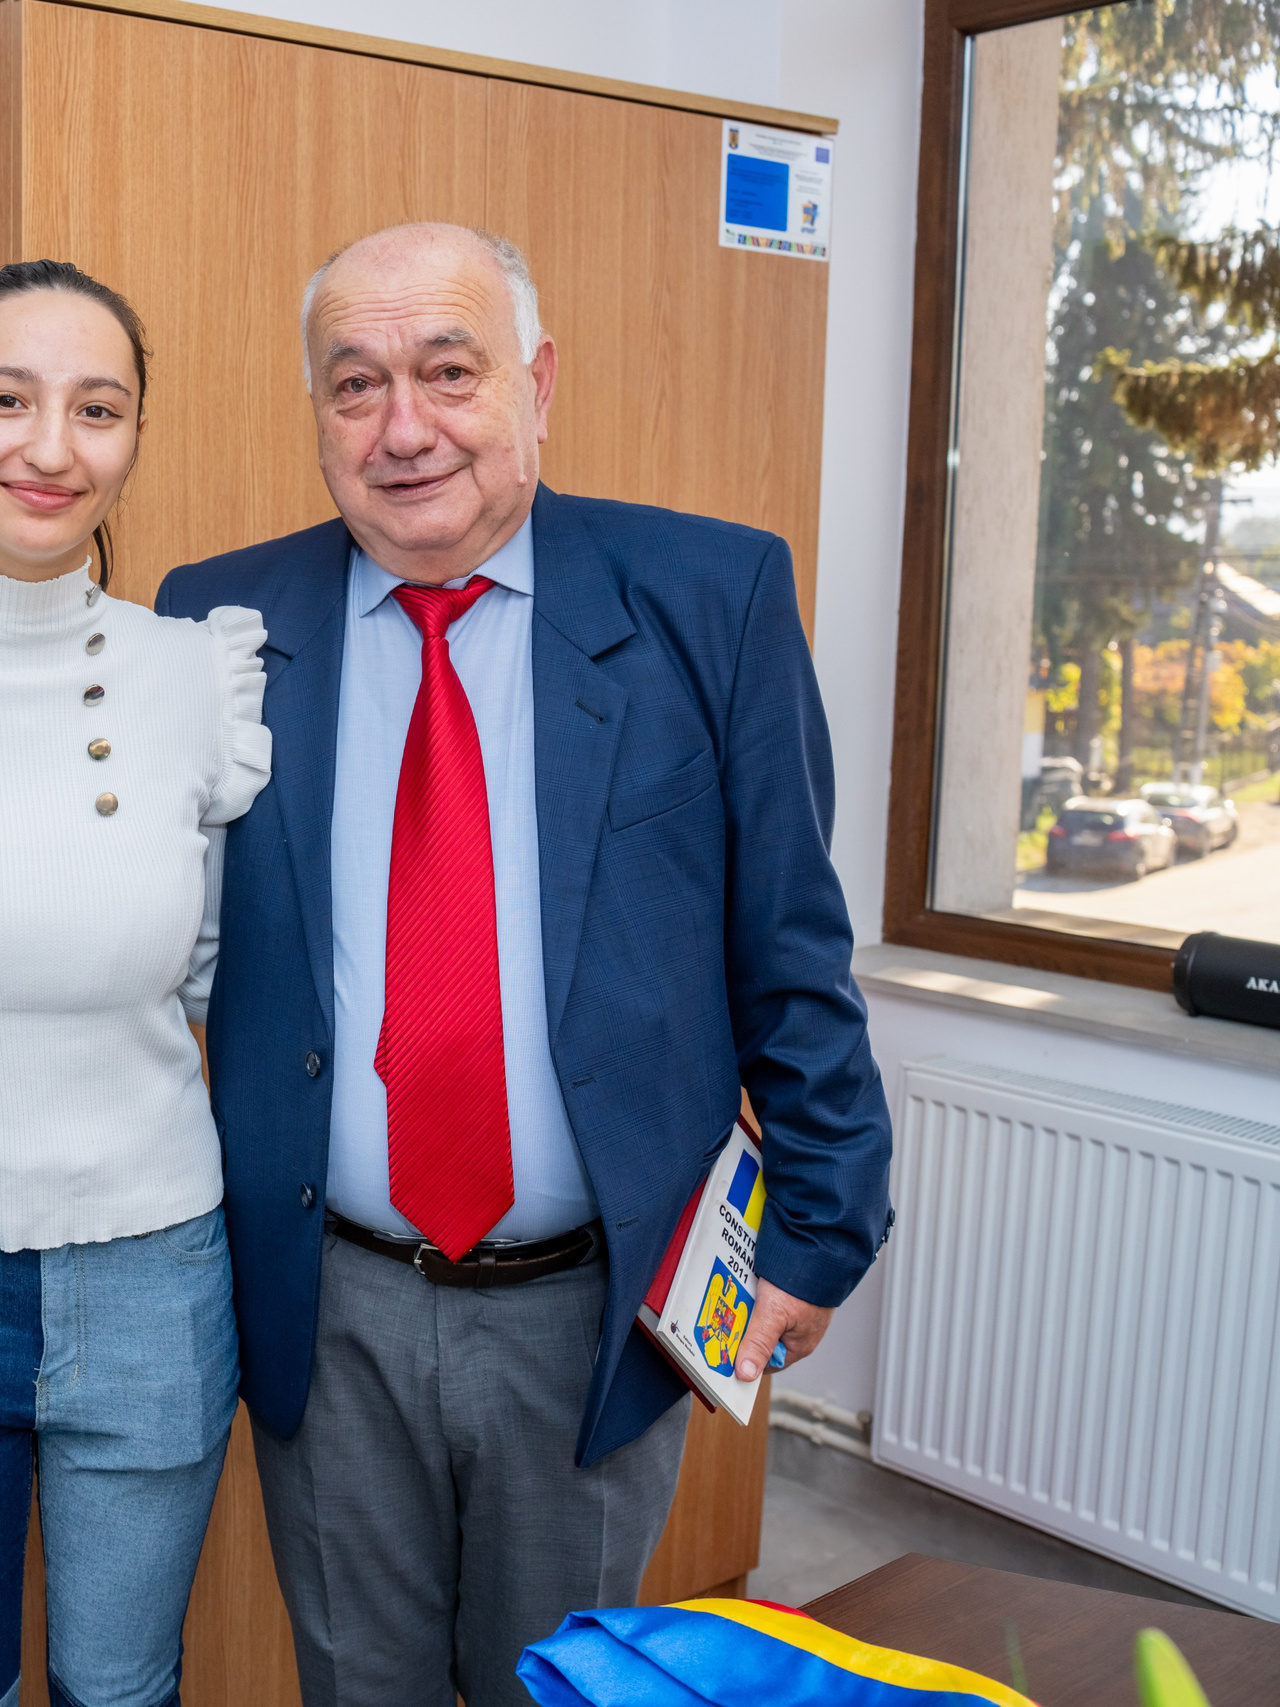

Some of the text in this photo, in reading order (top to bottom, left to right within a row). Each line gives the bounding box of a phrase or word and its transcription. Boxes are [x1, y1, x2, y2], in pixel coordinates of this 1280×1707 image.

[1245, 976, 1280, 994] AKA
[719, 1204, 756, 1252] CONSTIT
[727, 1255, 749, 1284] 2011
